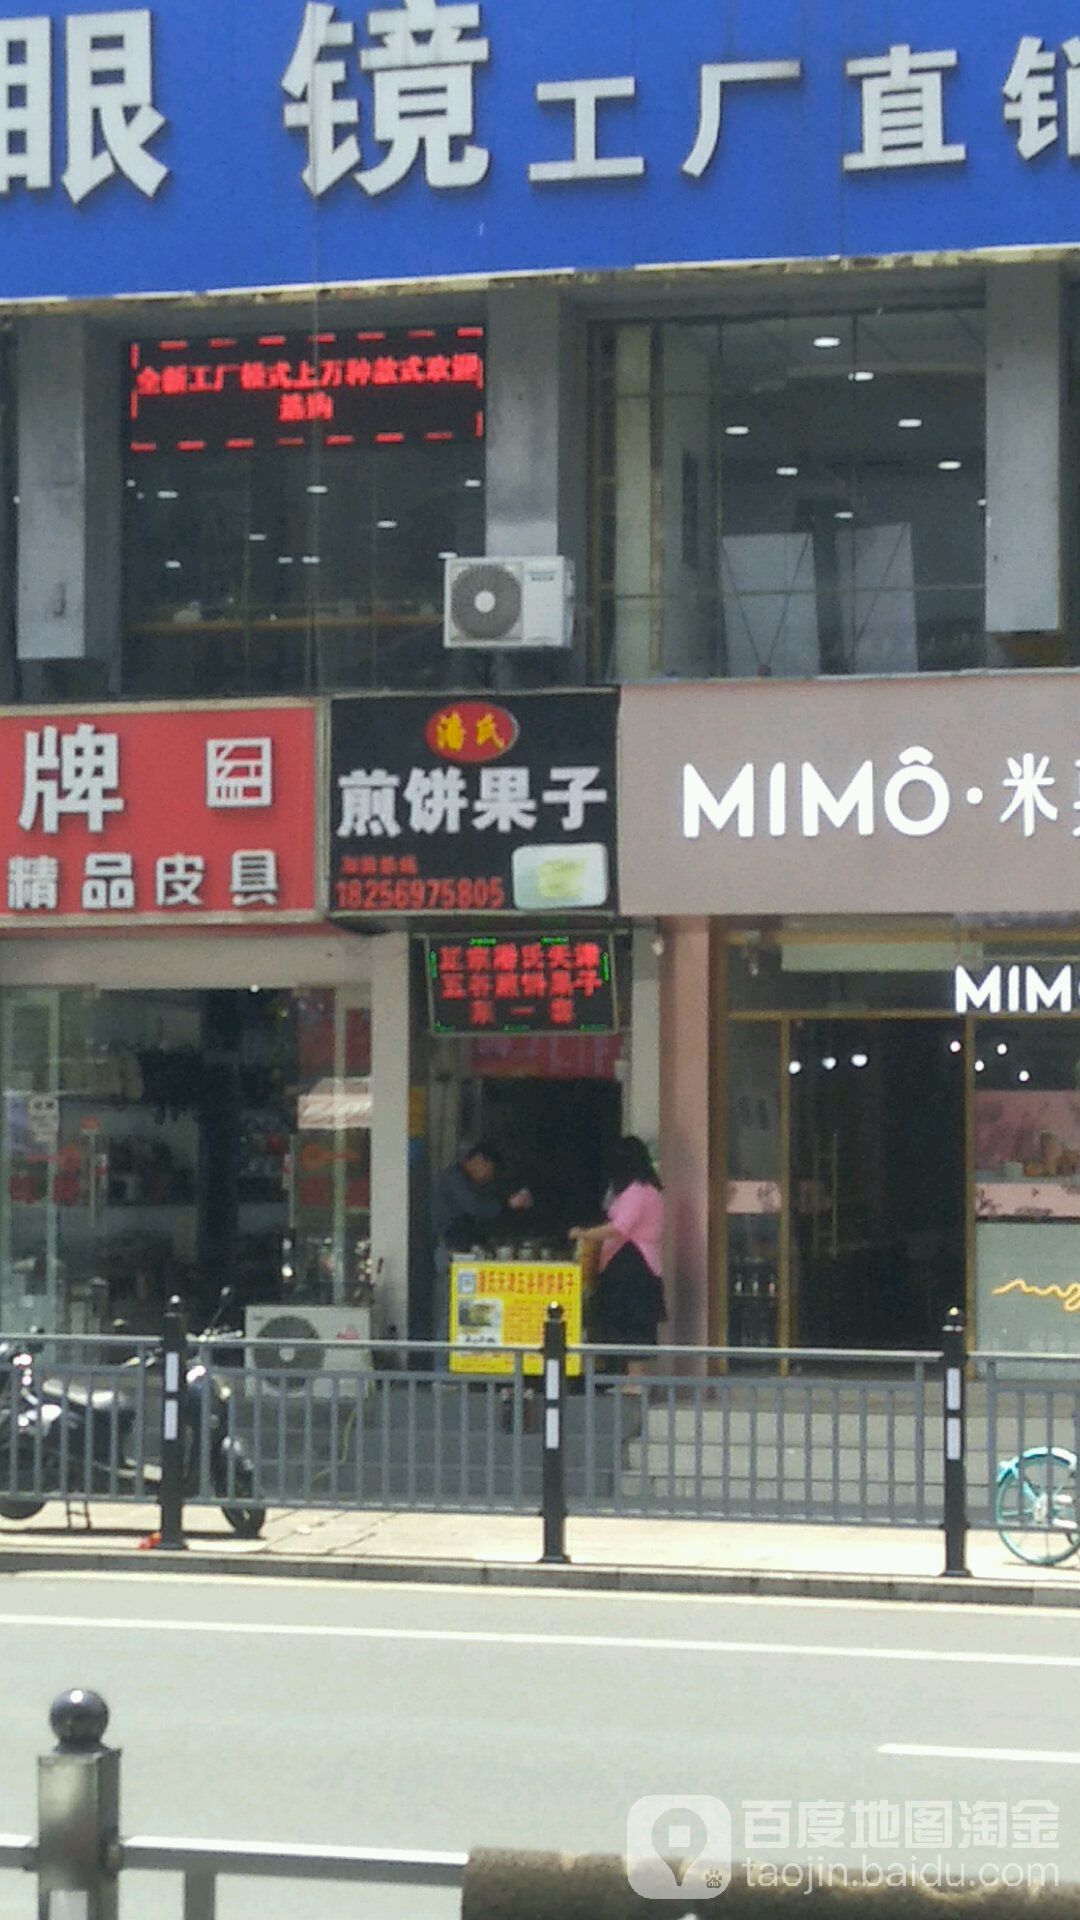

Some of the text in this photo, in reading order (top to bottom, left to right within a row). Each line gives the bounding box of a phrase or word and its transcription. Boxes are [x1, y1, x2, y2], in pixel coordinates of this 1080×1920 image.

[18, 723, 124, 833] 牌
[336, 766, 607, 838] 煎饼果子
[7, 850, 279, 909] 精品皮具
[335, 877, 505, 910] 18256975805
[955, 964, 1080, 1014] MIM
